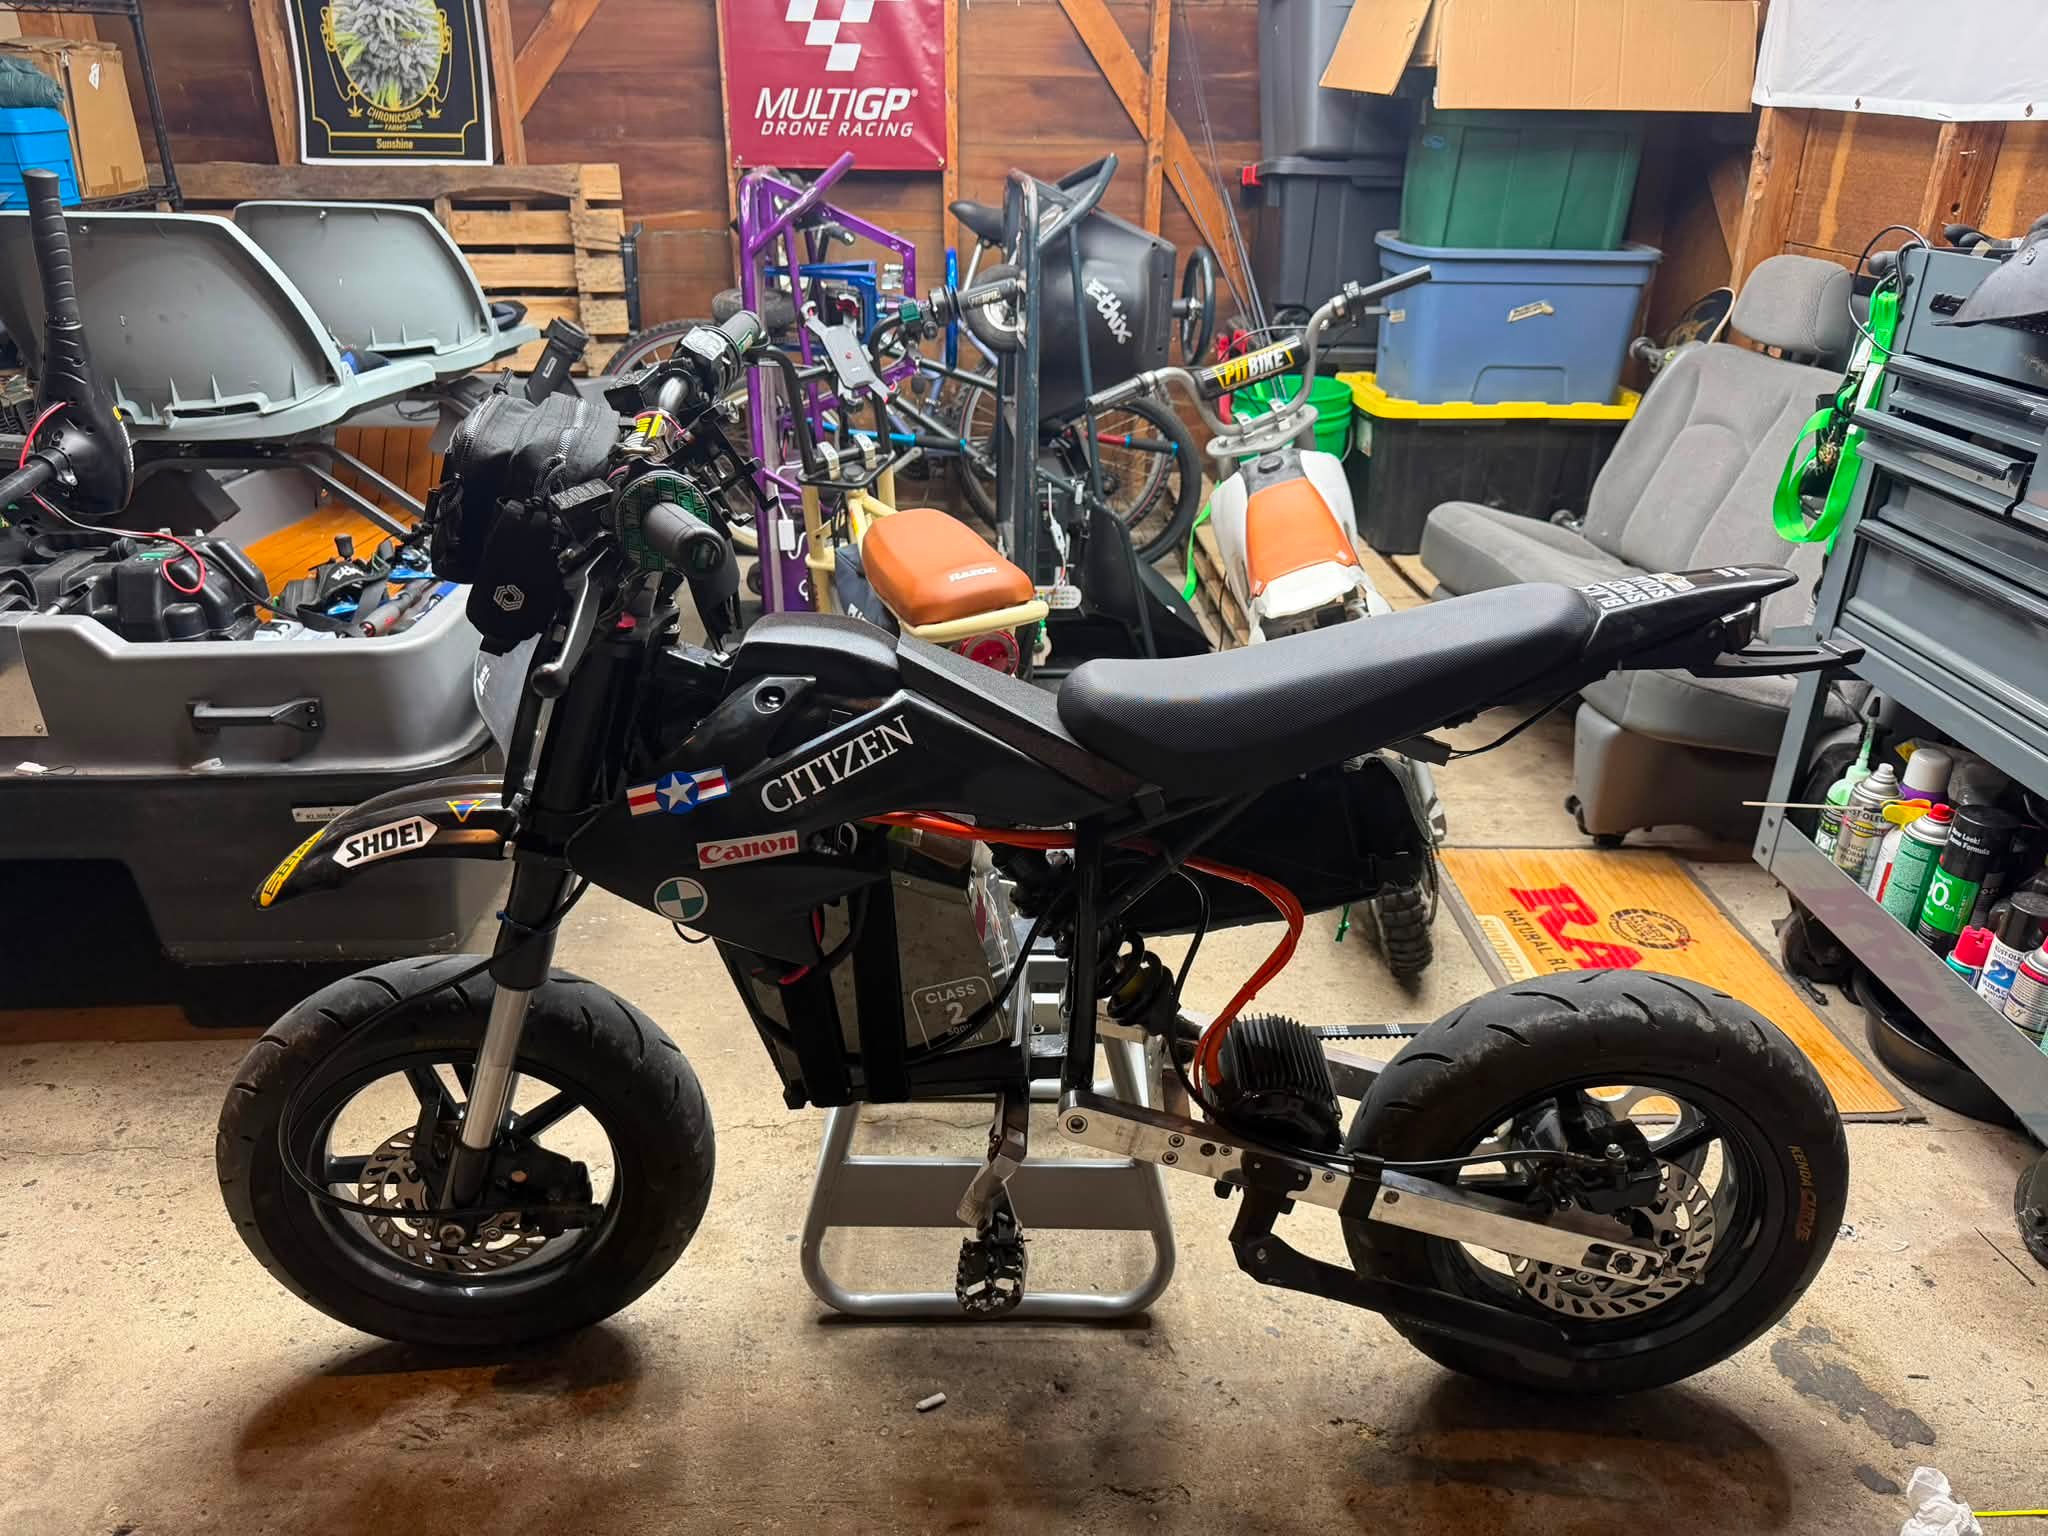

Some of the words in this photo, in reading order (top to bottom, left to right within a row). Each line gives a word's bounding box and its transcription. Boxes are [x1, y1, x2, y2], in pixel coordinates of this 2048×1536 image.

[761, 121, 831, 136] DRONE
[838, 121, 914, 137] RACING
[376, 138, 414, 150] Sunshine
[1086, 278, 1132, 345] Ethix
[761, 714, 914, 813] CITIZEN
[346, 821, 424, 863] SHOEI
[699, 835, 797, 864] Canon
[1504, 908, 1552, 955] NATURAL
[925, 983, 977, 1004] CLASS
[946, 1001, 968, 1025] 2
